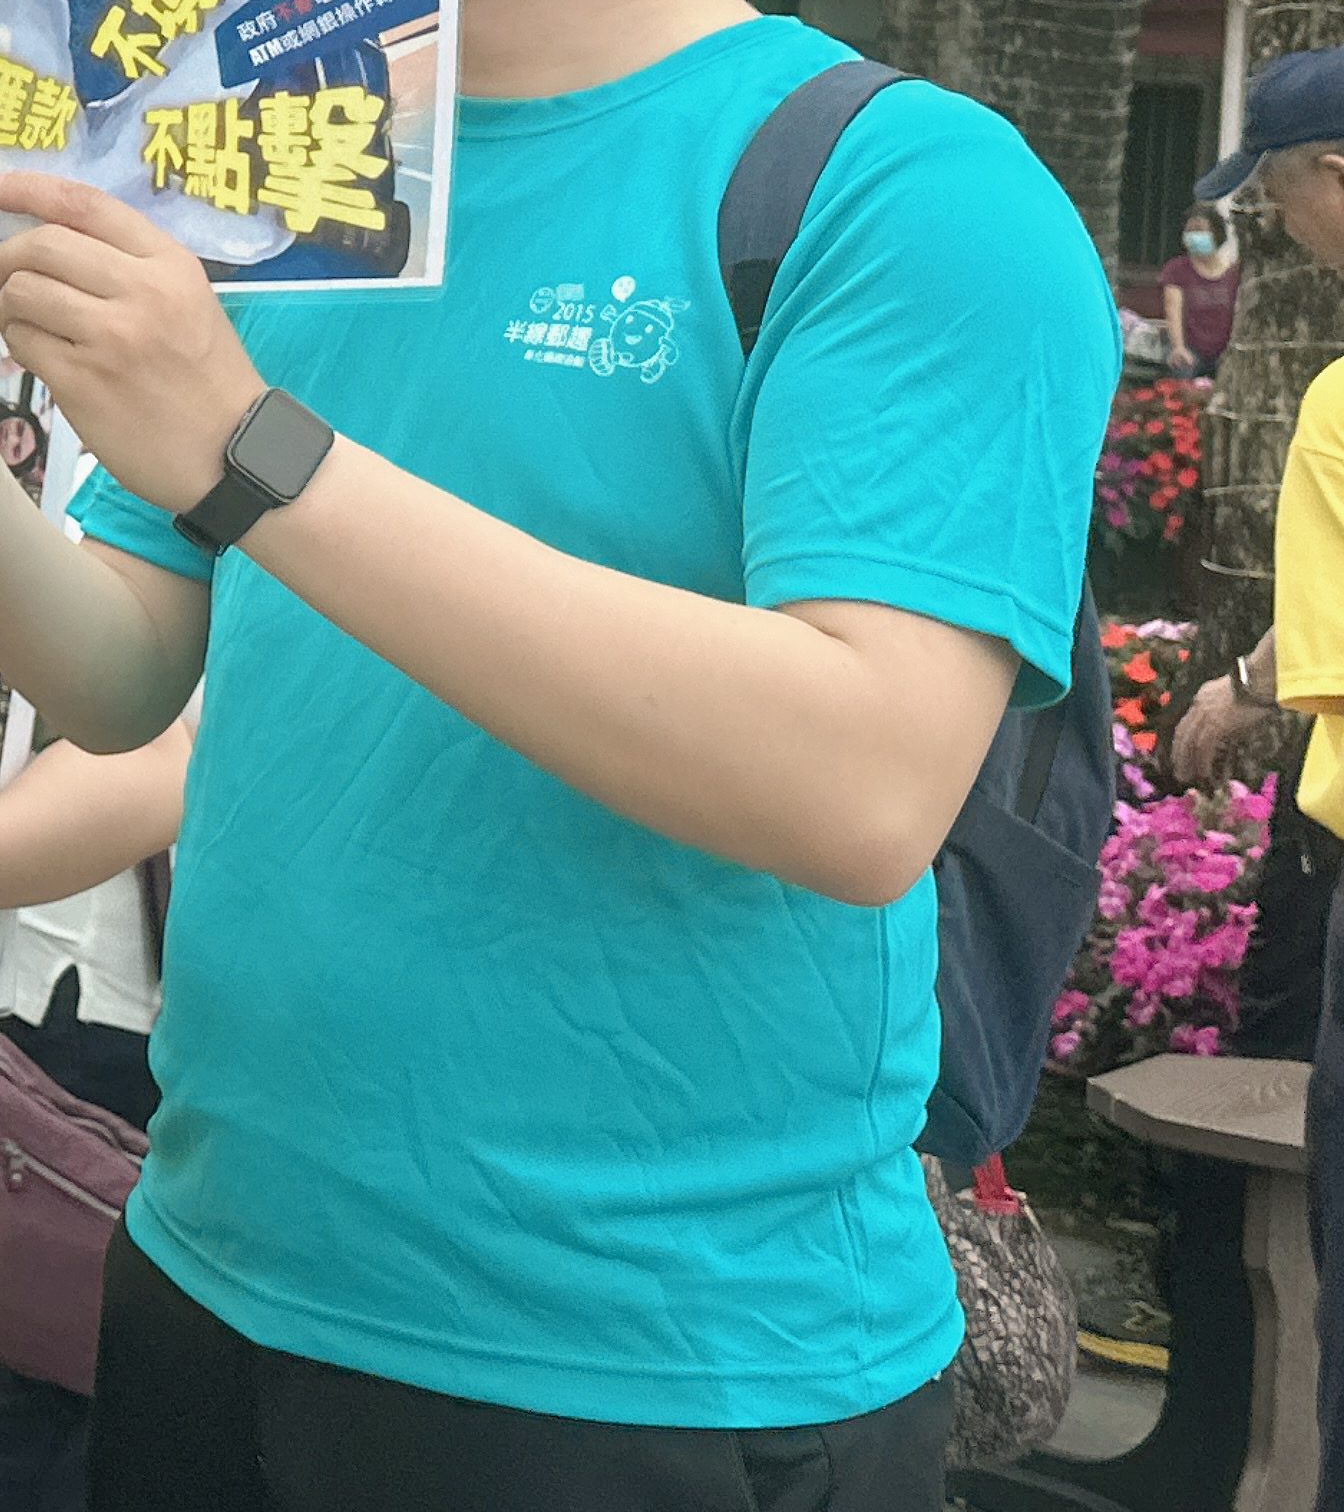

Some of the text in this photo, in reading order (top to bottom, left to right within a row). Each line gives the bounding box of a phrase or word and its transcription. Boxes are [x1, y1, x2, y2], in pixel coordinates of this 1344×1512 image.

[143, 83, 390, 234] 不點擊
[552, 303, 597, 323] 2015
